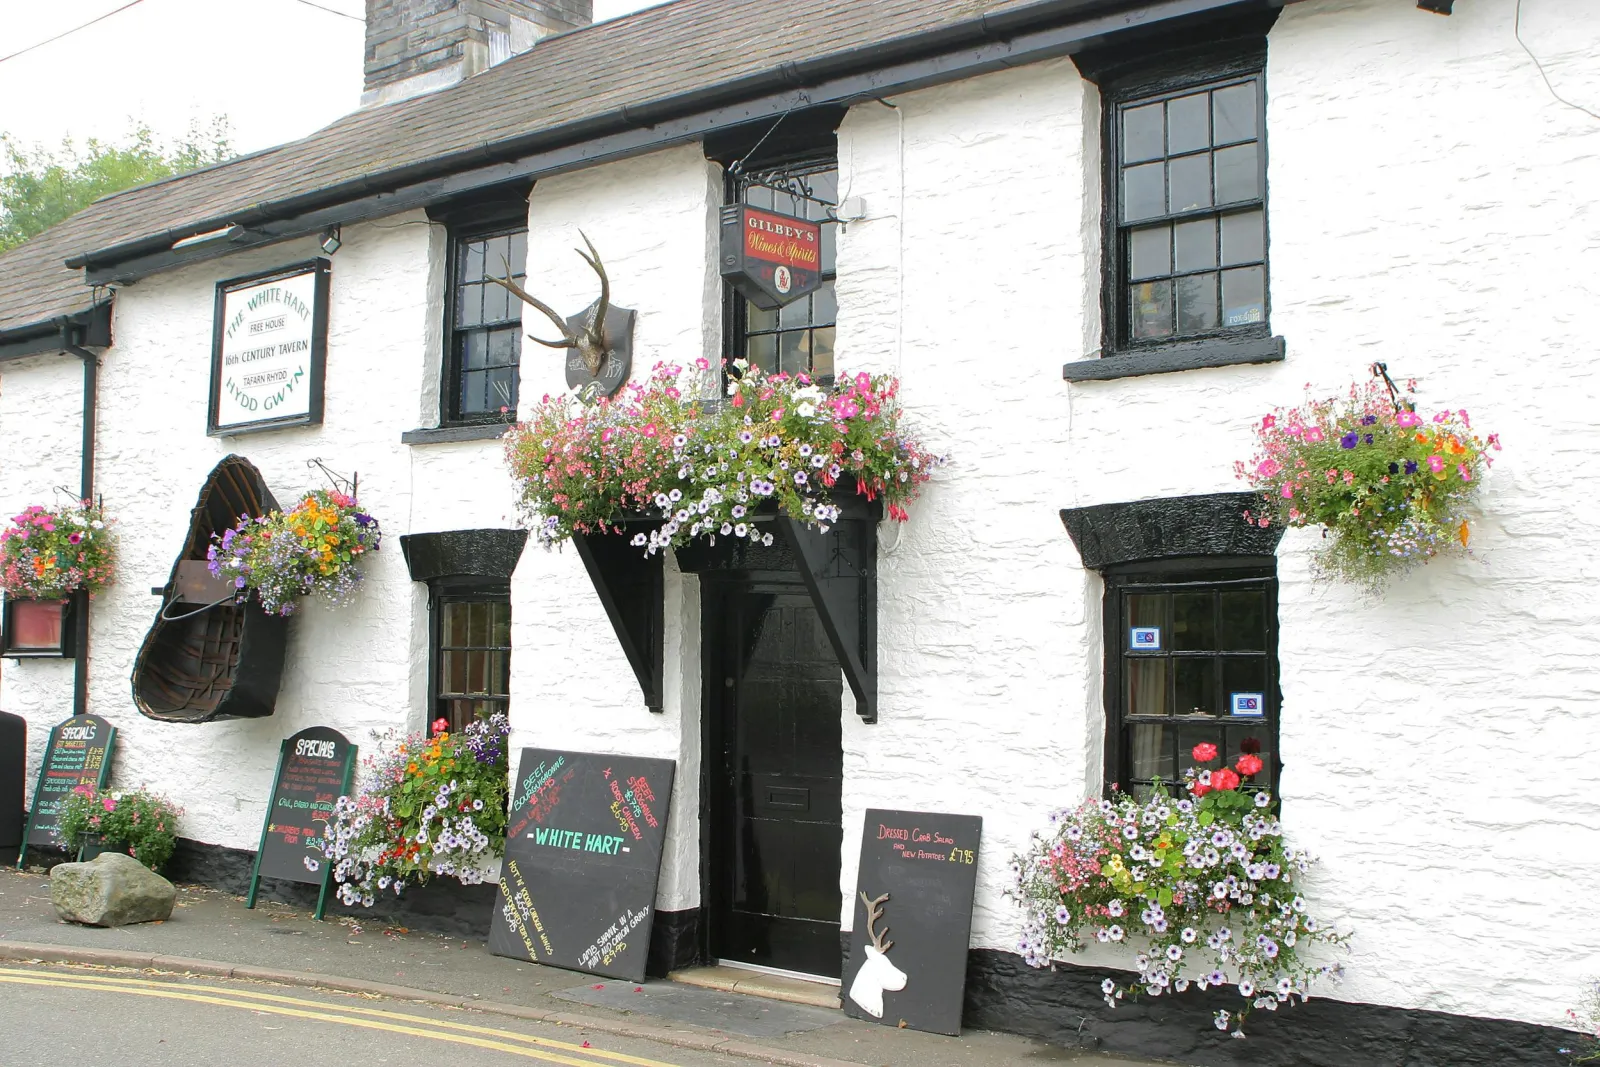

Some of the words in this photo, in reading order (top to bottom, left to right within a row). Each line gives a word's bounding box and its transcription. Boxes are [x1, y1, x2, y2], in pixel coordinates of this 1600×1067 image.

[748, 217, 814, 242] GILBEY'S
[748, 231, 777, 254] Wines
[777, 241, 785, 258] &
[785, 241, 817, 263] Spirits
[226, 309, 245, 339] THE
[247, 288, 281, 312] WHITE
[284, 290, 311, 322] HART
[250, 322, 263, 333] FREE
[265, 318, 285, 330] HOUSE
[225, 354, 239, 366] 16th
[241, 346, 276, 363] CENTURY
[278, 340, 308, 355] TAVERN
[226, 377, 258, 411] HYDD
[263, 365, 304, 410] GWYN
[243, 375, 266, 386] TAFARN
[266, 371, 288, 382] RHYDD
[61, 726, 97, 740] SPECIALS
[295, 738, 336, 759] SPECIALS
[513, 755, 565, 812] BOURGUIGNONNE
[522, 760, 546, 790] BEEF
[636, 776, 655, 802] BEEF
[609, 779, 626, 804] ROAST
[622, 805, 643, 840] CHICKEN
[610, 800, 629, 832] £6.95
[626, 776, 659, 829] STROGANOFF
[876, 823, 909, 841] DRESSED
[901, 850, 917, 858] NEW
[917, 849, 946, 861] POTATOES
[948, 847, 974, 865] £7.95
[499, 876, 510, 897] COLD
[506, 894, 522, 925] POACHED
[524, 937, 539, 961] SALMON
[508, 860, 520, 878] HOT
[529, 907, 544, 933] CHICKEN
[540, 932, 554, 956] WINGS
[577, 944, 598, 967] LAMB
[596, 922, 619, 947] SHANK
[618, 914, 627, 926] IN
[627, 909, 634, 919] A
[587, 950, 602, 970] MINT
[611, 924, 630, 947] ONION
[629, 904, 650, 929] GRAVY
